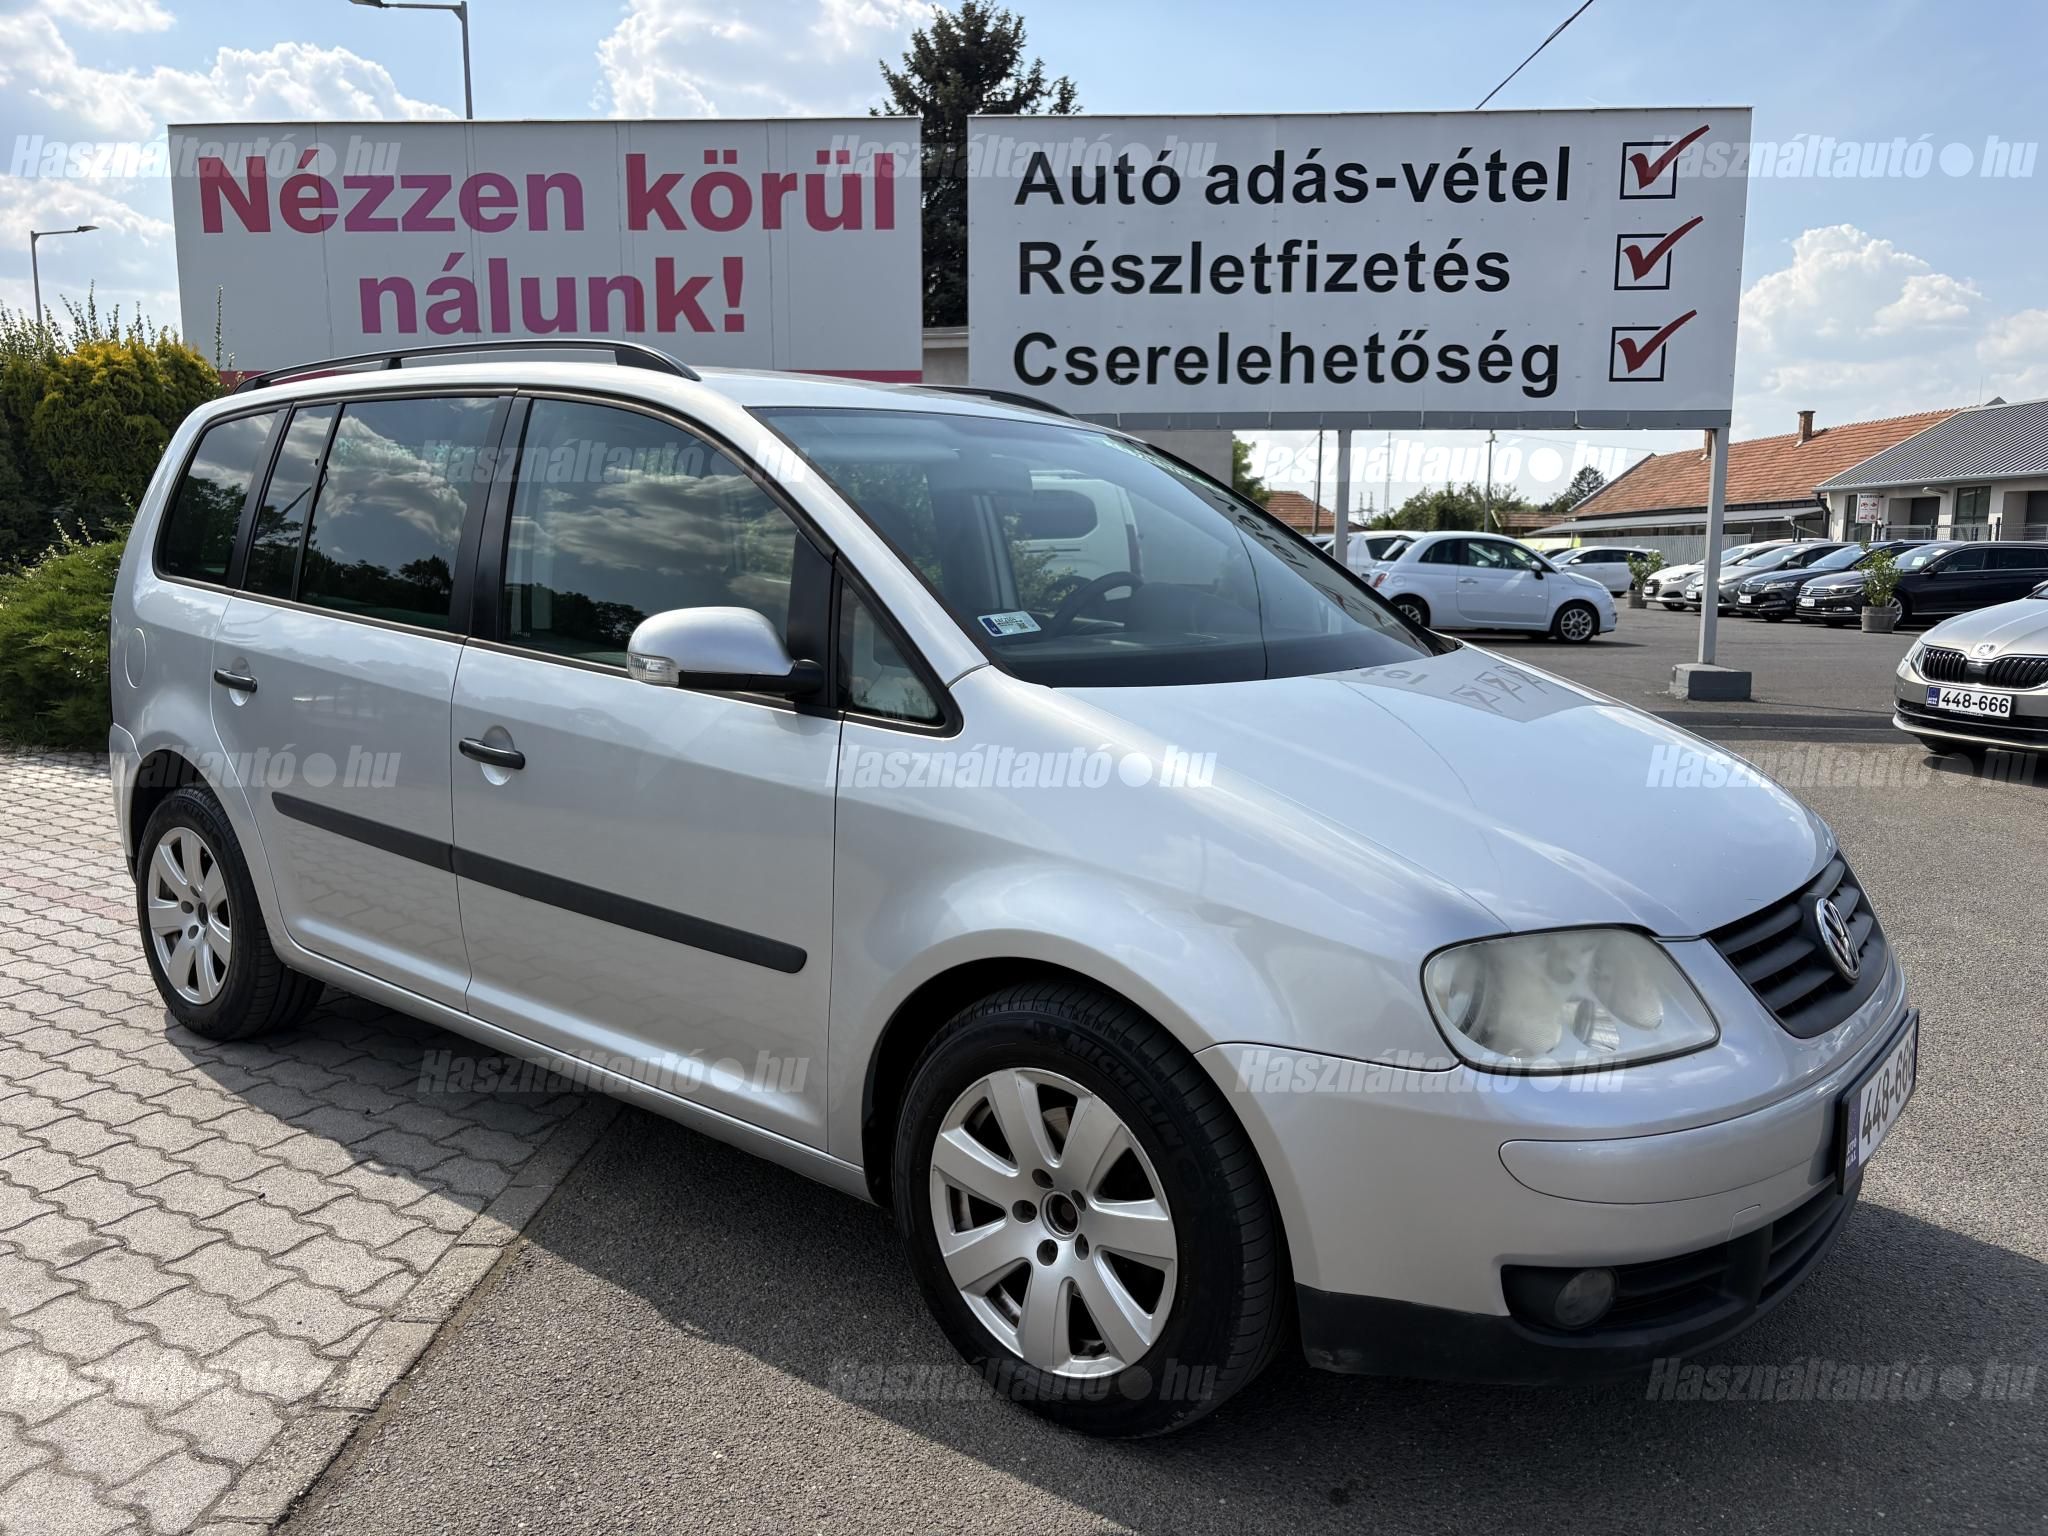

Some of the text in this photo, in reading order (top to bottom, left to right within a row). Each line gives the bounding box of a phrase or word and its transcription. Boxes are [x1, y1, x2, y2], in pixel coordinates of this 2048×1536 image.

[199, 150, 893, 234] Nézzen körül
[1014, 146, 1570, 206] Autó adás-vétel
[361, 254, 744, 334] nálunk!
[1019, 238, 1510, 296] Részletfizetés
[1013, 330, 1560, 399] Cserelehetőség
[1941, 691, 2009, 714] 448-666
